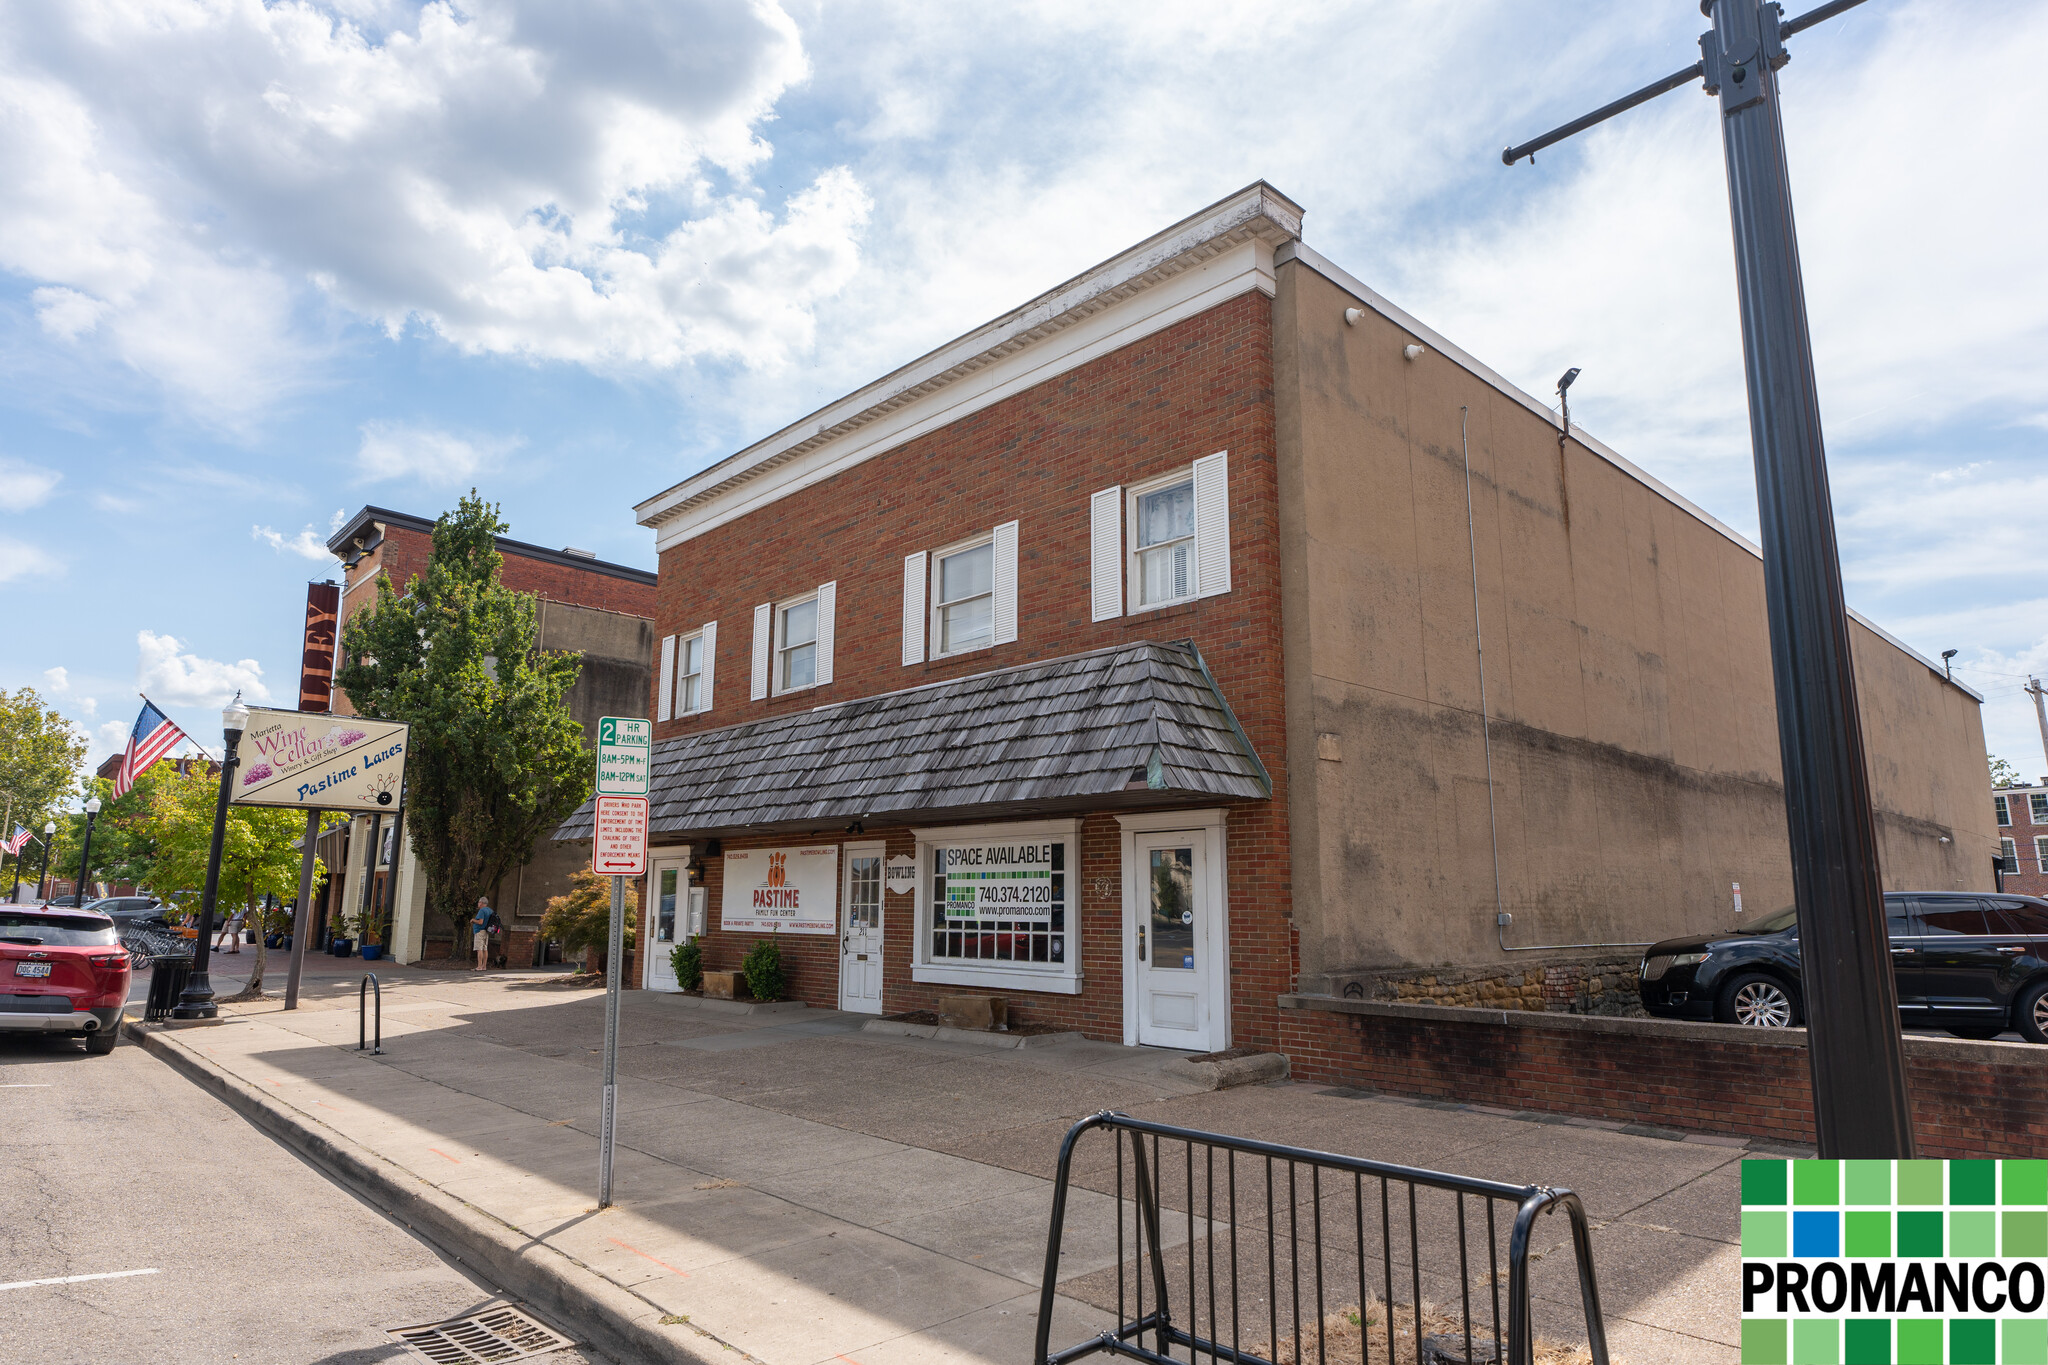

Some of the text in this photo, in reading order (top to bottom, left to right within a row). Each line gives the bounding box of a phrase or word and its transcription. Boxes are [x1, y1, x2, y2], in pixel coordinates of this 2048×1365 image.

[301, 601, 338, 711] LLEY
[250, 724, 282, 740] Marietta
[602, 723, 640, 741] 2 HR
[616, 734, 647, 745] PARKING
[255, 727, 306, 756] Wine
[273, 734, 334, 767] Cellars
[281, 761, 302, 774] Winery
[311, 752, 323, 763] Gift
[323, 747, 338, 757] Shop
[602, 754, 646, 765] 8AM-5PM M-F
[297, 743, 403, 801] Pastime Lanes
[601, 771, 635, 782] 8AM-12PM
[947, 844, 1050, 866] SPACE AVAILABLE
[887, 866, 916, 879] BOWLING
[753, 889, 800, 908] PASTIME
[979, 886, 1050, 902] 740.374.2120
[770, 909, 779, 917] FUN
[946, 901, 975, 909] PROMANCO
[979, 906, 1051, 917] www.promanco.com
